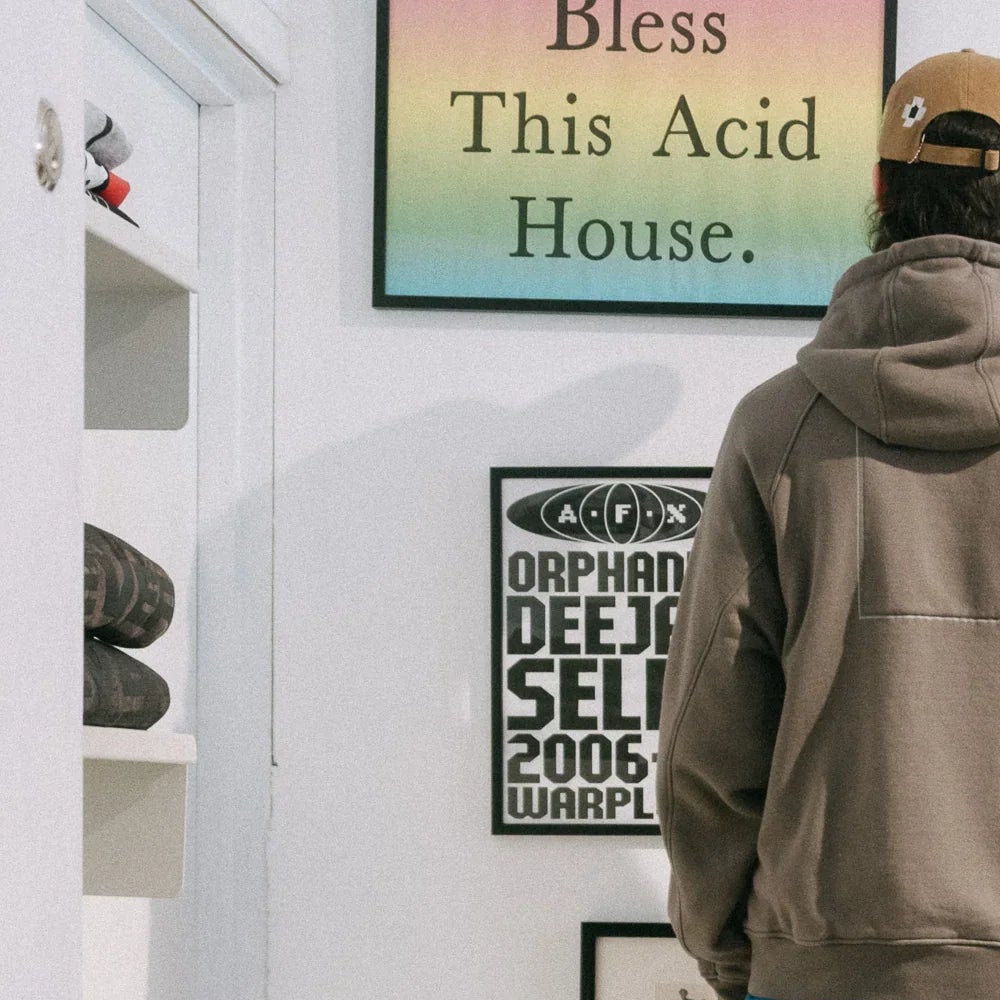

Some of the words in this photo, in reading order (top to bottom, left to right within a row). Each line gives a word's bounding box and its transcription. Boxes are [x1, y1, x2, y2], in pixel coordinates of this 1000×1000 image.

[546, 0, 727, 54] Bless
[450, 90, 613, 156] This
[652, 94, 821, 161] Acid
[509, 196, 756, 264] House.
[507, 551, 693, 593] ORPHAN
